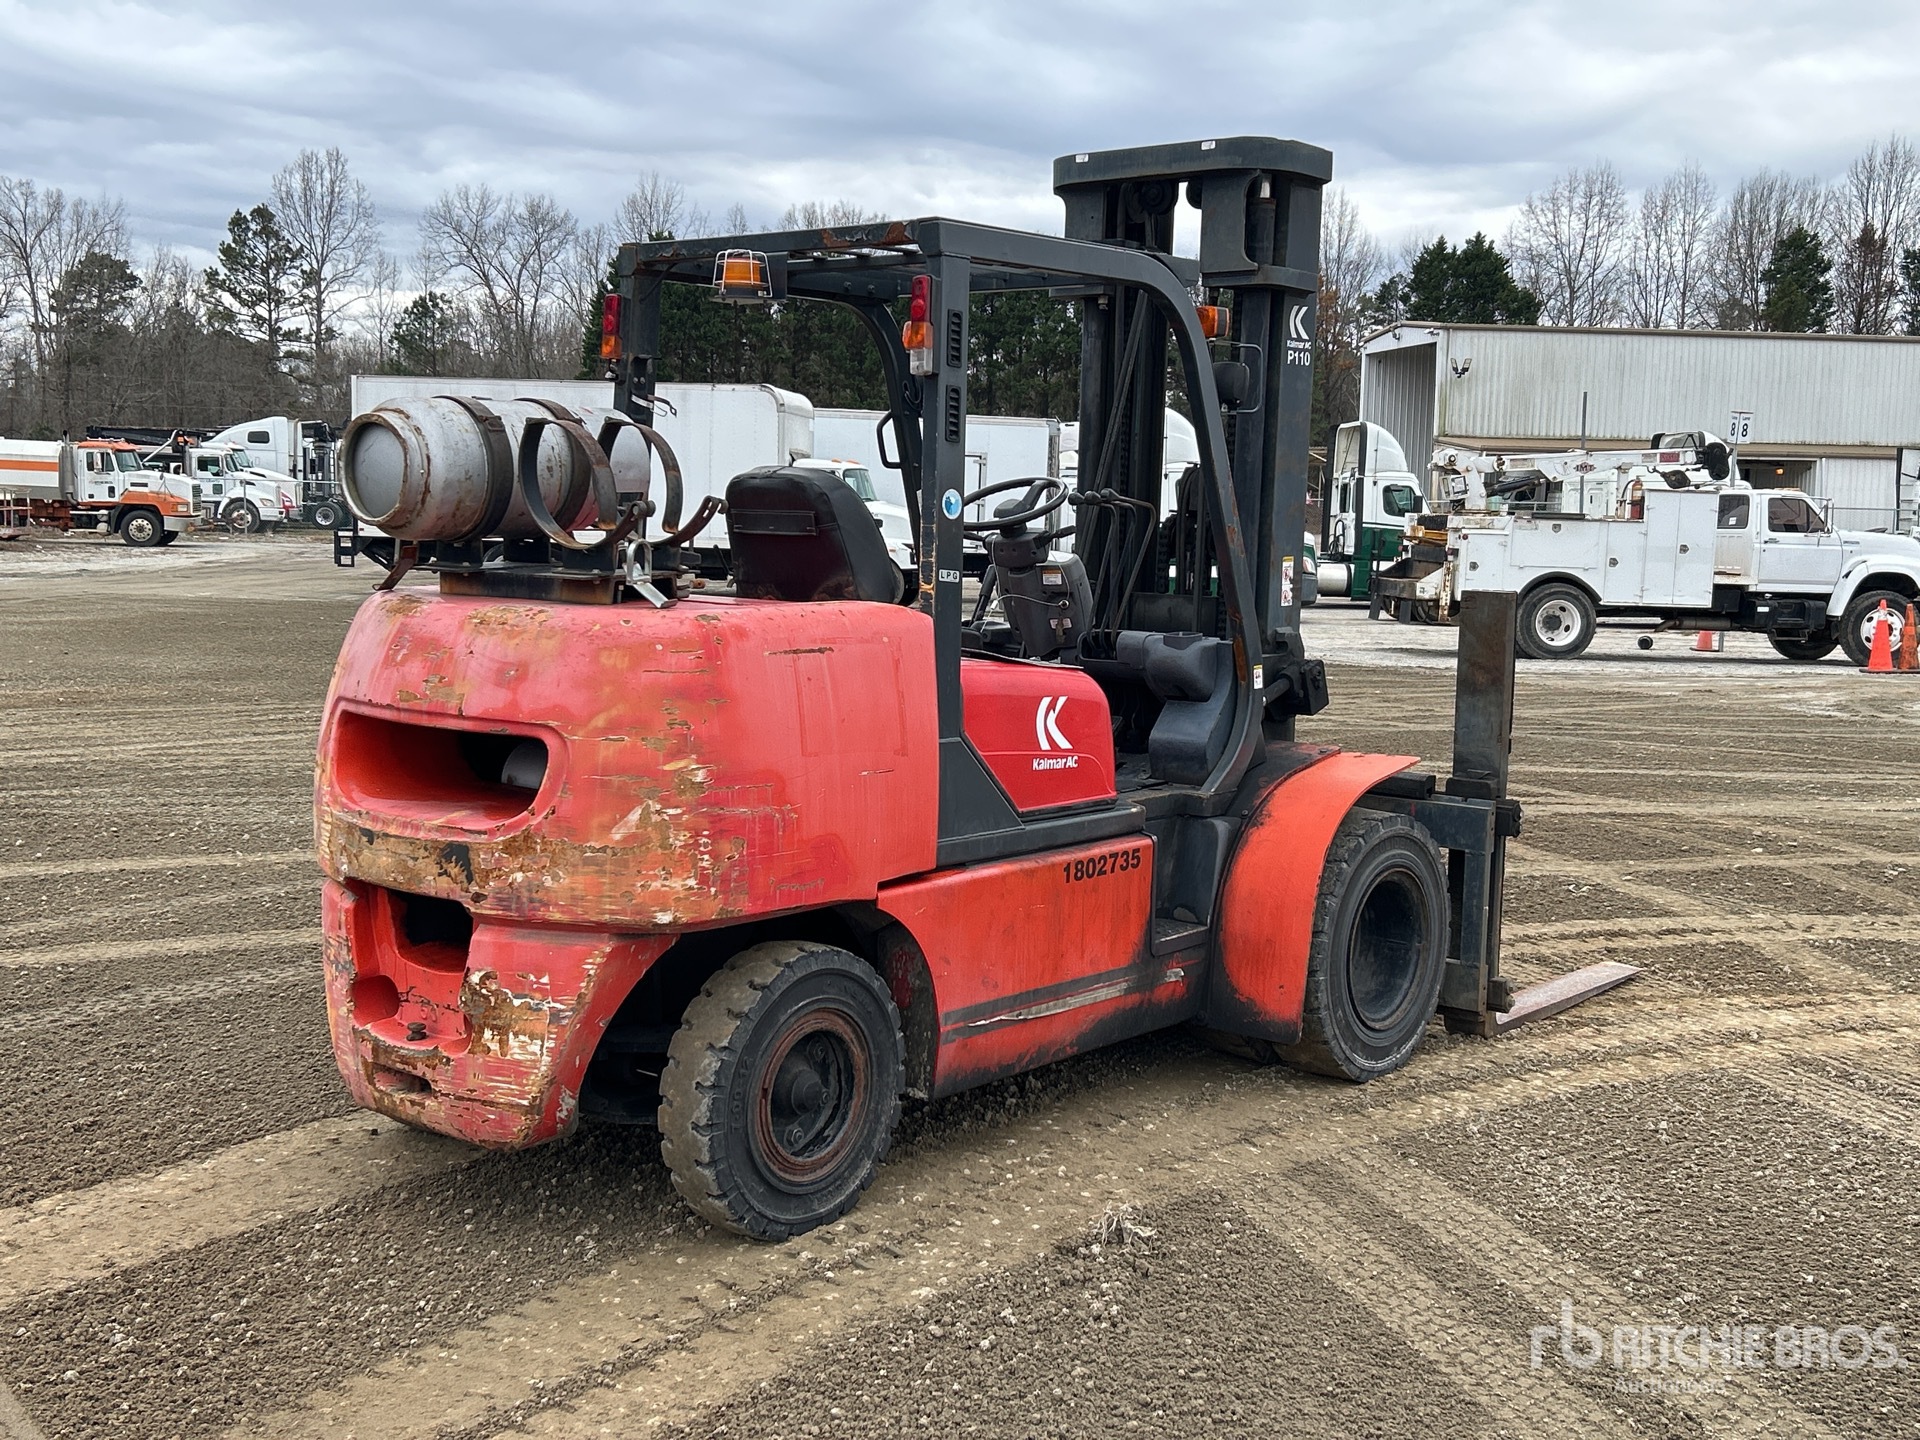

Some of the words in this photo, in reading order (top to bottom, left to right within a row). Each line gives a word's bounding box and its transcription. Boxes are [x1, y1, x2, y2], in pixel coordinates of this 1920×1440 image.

[1287, 350, 1311, 366] P110
[1730, 422, 1736, 437] 8
[1741, 423, 1748, 437] 8
[1063, 848, 1141, 884] 1802735
